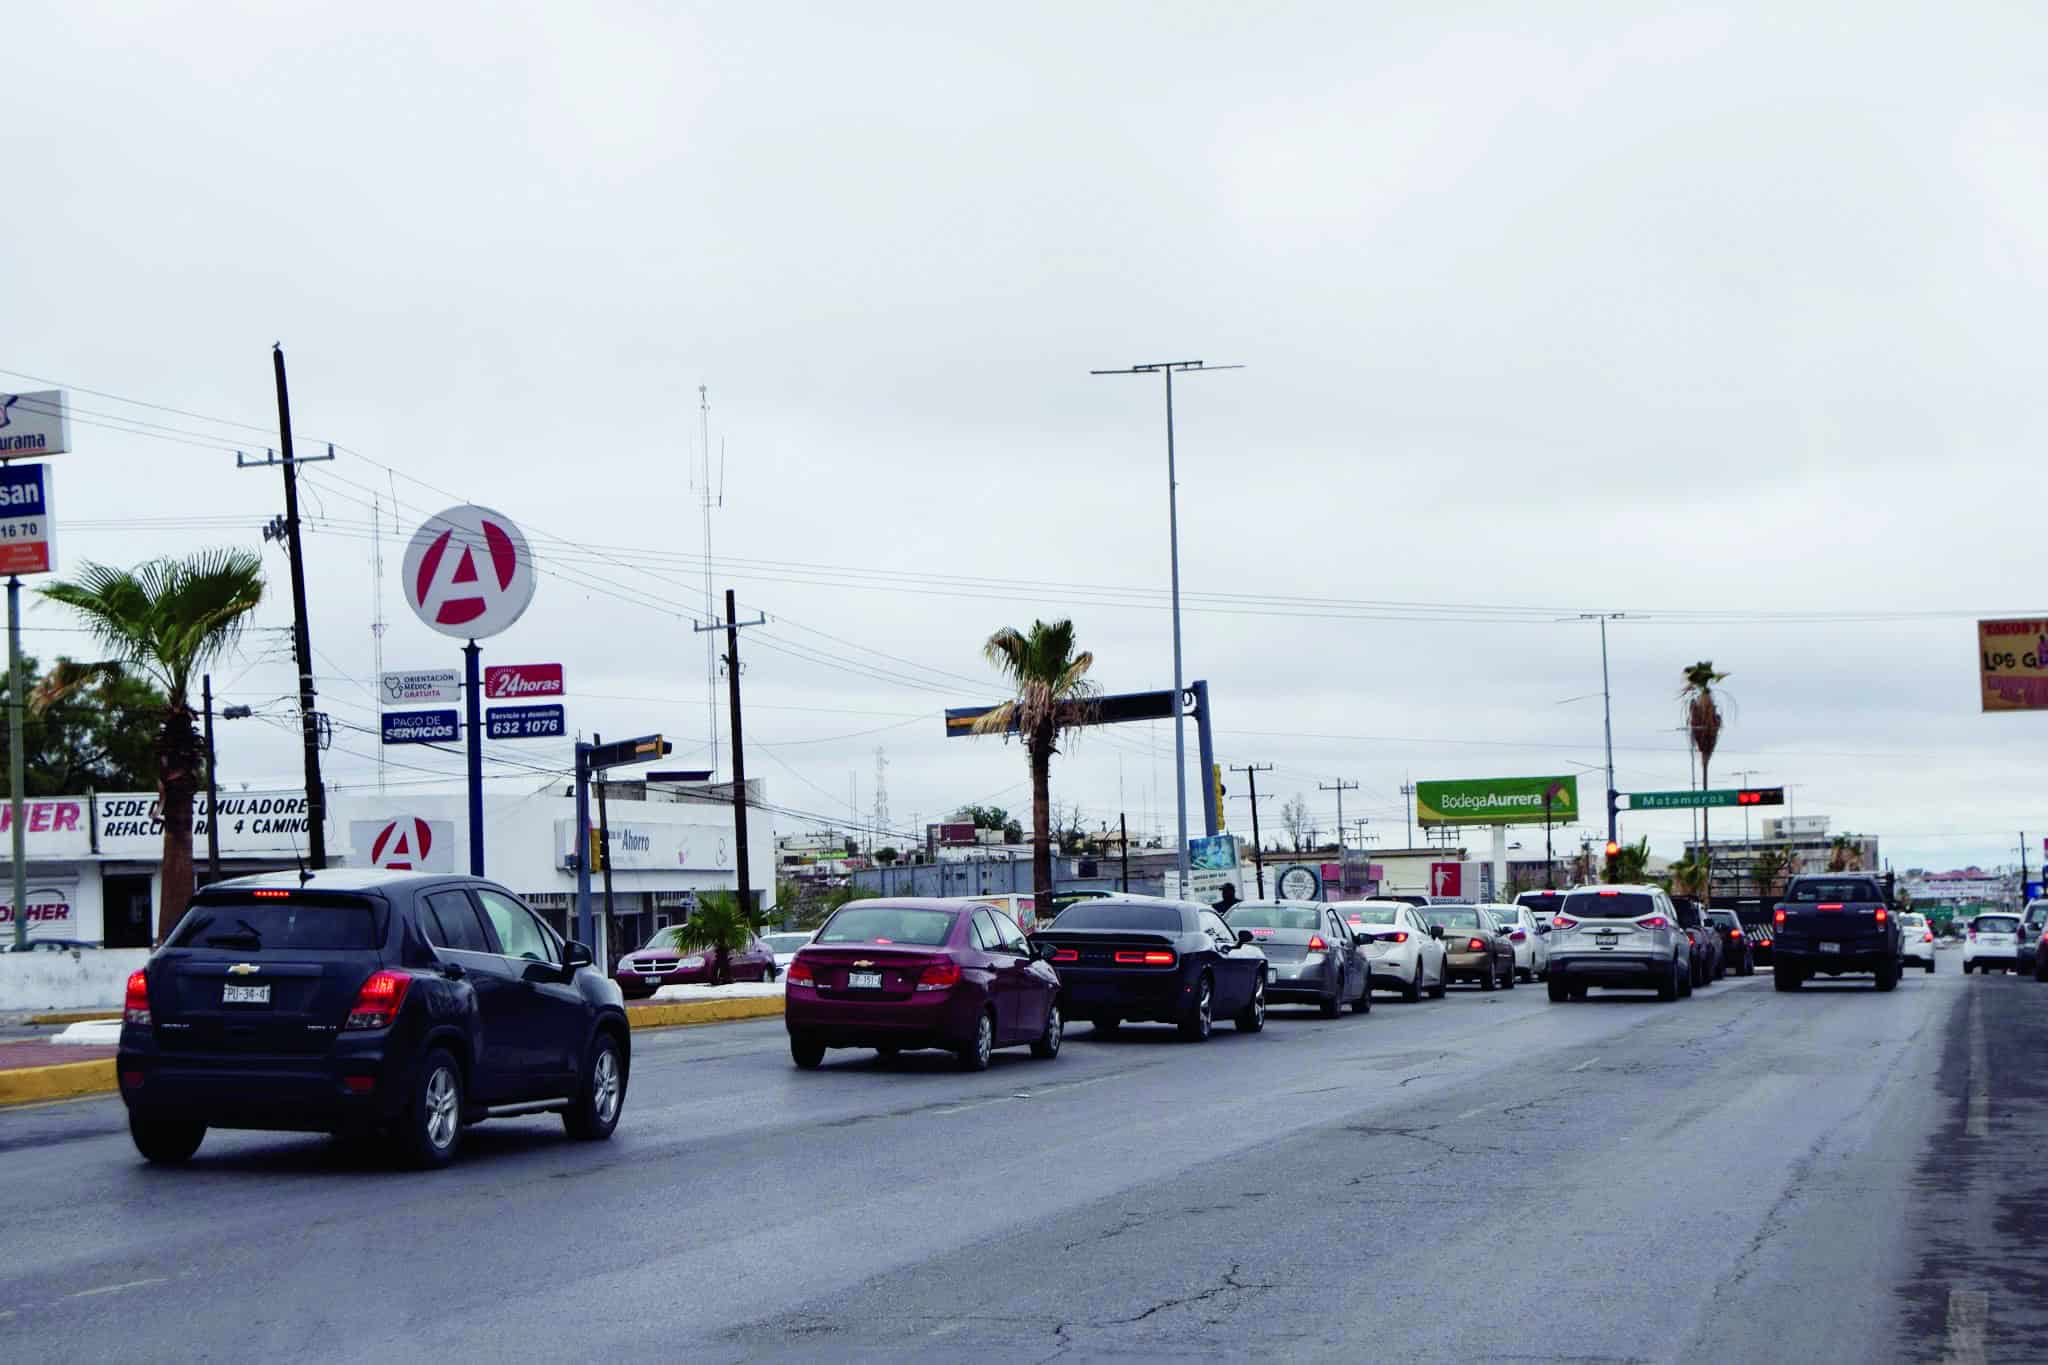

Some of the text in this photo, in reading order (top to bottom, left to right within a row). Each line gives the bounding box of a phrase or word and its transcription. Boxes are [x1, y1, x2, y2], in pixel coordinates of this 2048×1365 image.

[21, 523, 37, 536] 70
[393, 716, 441, 727] PAGO DE
[493, 722, 520, 734] 632
[385, 726, 454, 740] SERVICIOS
[102, 800, 148, 817] SEDE
[234, 819, 245, 835] 4
[252, 818, 310, 834] CAMINO
[622, 829, 650, 851] Ahorro
